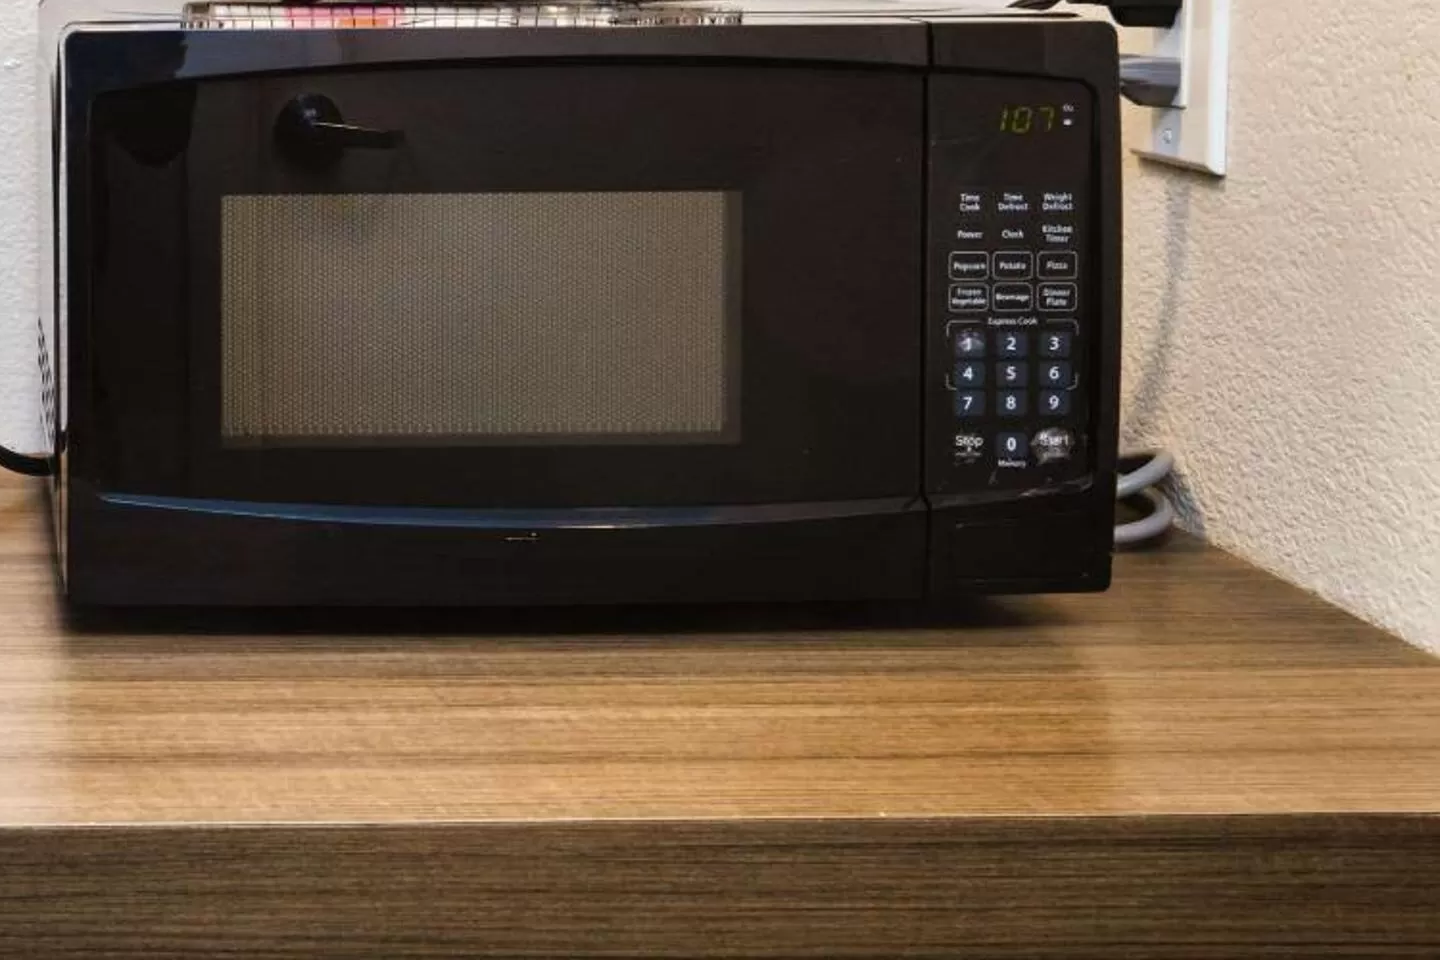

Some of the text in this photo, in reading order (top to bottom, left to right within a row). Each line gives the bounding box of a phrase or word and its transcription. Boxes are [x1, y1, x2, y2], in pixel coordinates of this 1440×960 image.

[960, 193, 980, 201] Time
[1001, 230, 1024, 239] Clock
[953, 261, 986, 272] Popcorn
[999, 261, 1026, 270] Potato
[1046, 261, 1068, 270] Pizza
[988, 317, 1038, 326] Express Cook
[962, 337, 972, 351] 1
[1006, 337, 1016, 351] 2
[1050, 337, 1060, 351] 3
[963, 366, 973, 380] 4
[1006, 366, 1016, 380] 5
[1049, 366, 1059, 380] 6
[963, 396, 973, 410] 7
[1006, 396, 1016, 410] 8
[1049, 395, 1059, 410] 9
[955, 435, 984, 447] Stop
[1006, 437, 1016, 451] 0
